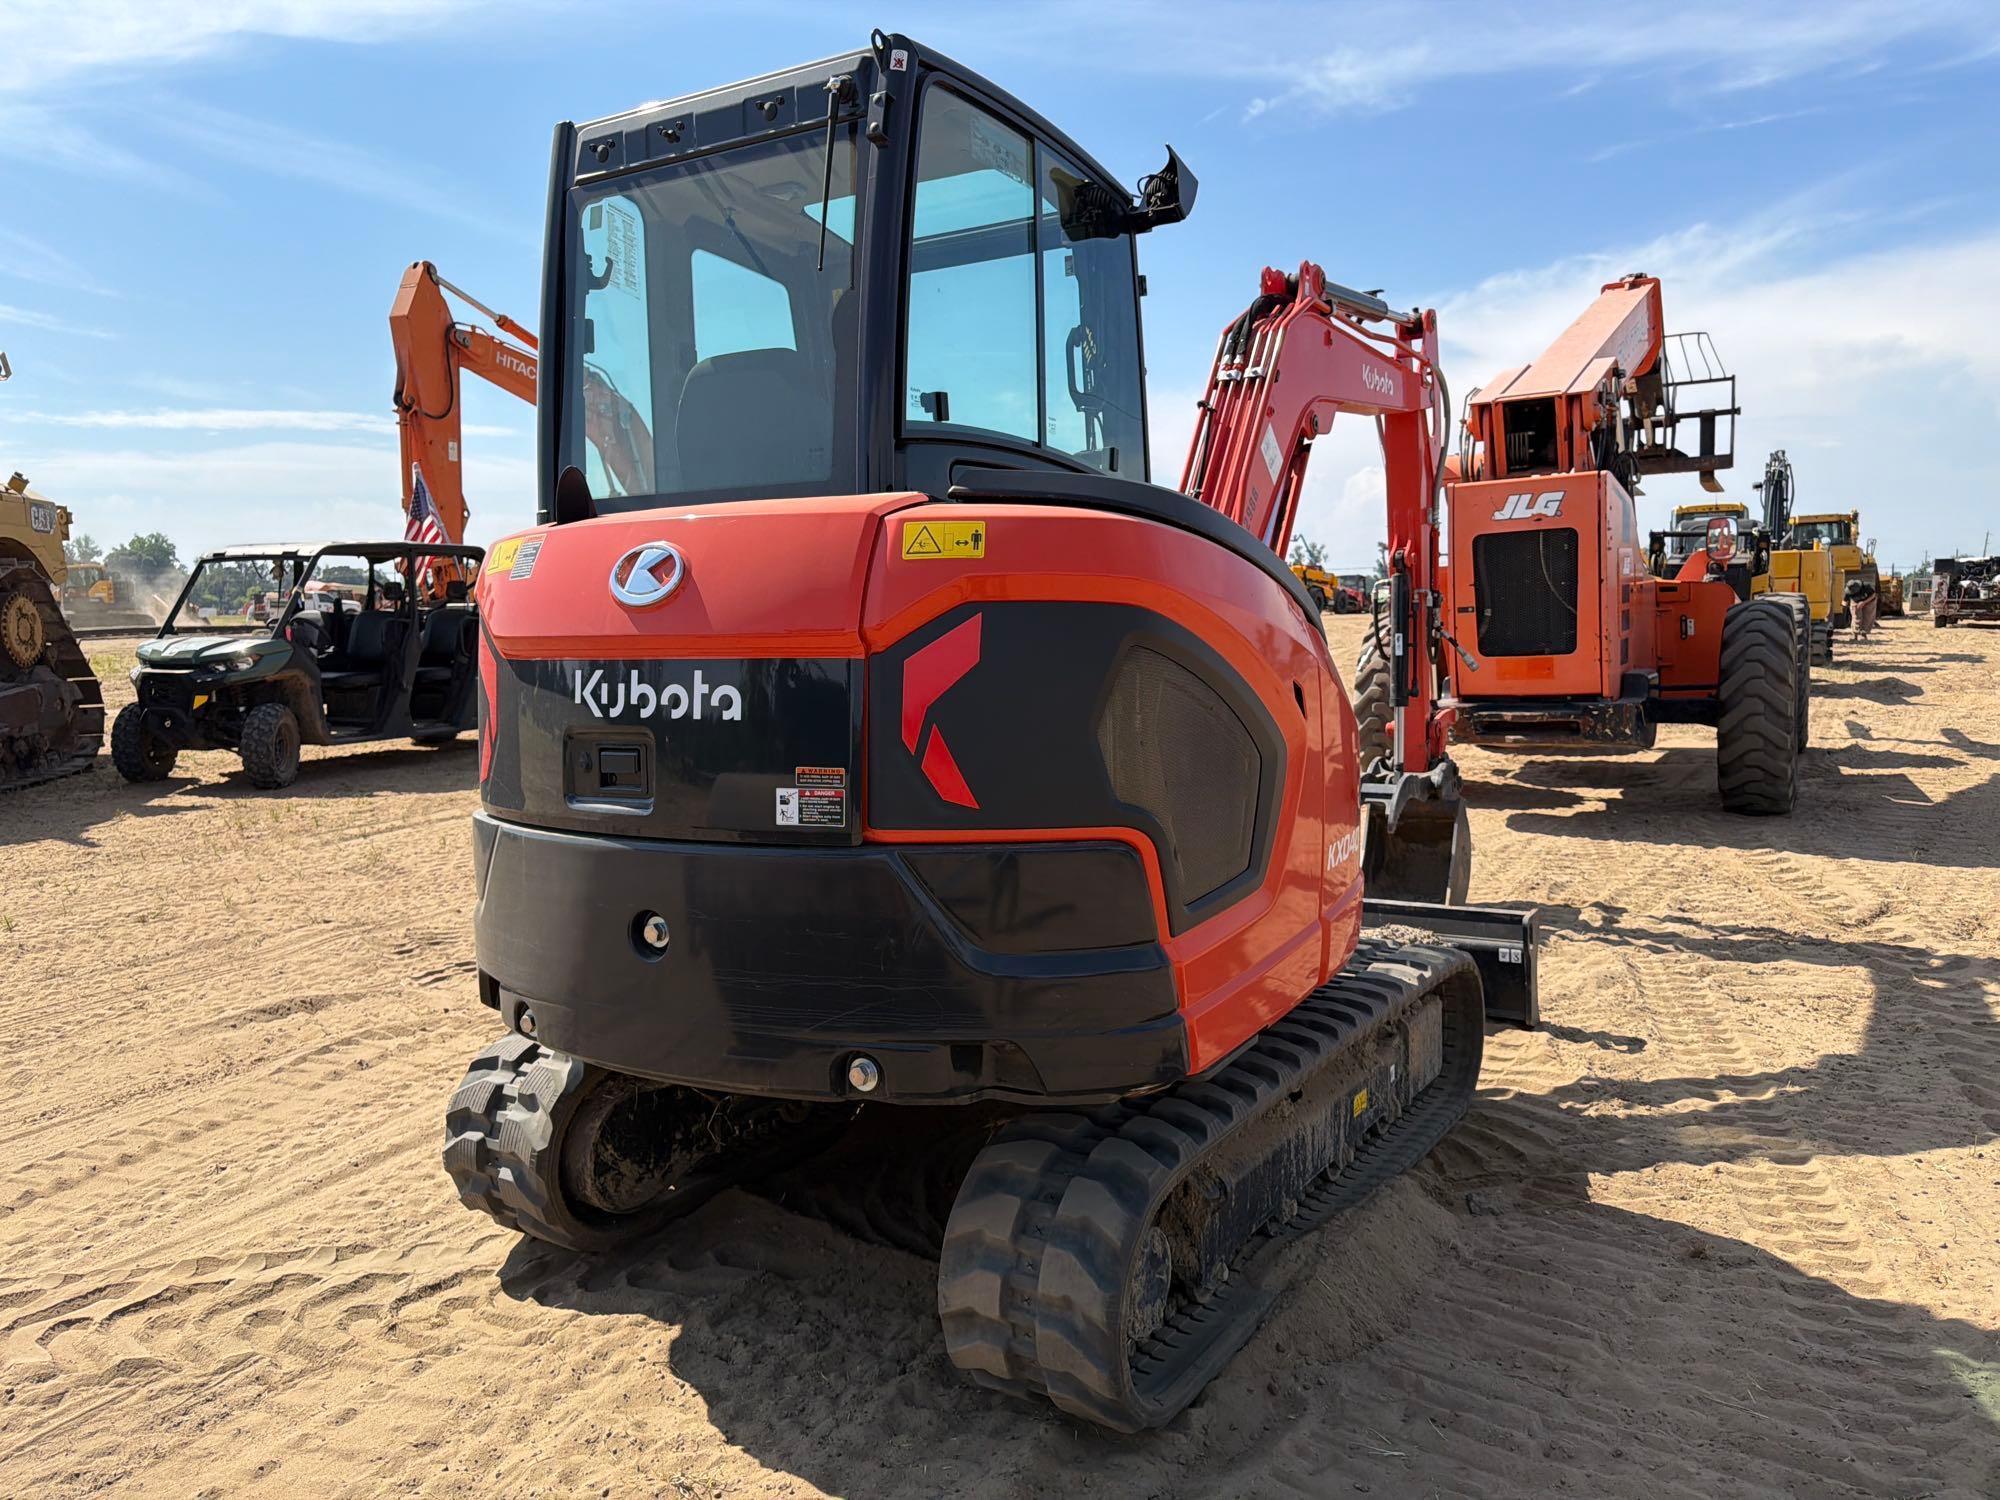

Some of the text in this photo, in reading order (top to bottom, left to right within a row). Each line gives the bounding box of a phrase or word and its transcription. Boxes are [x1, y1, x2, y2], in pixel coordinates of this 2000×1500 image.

[1362, 363, 1394, 396] Kubota
[1491, 490, 1566, 520] JLG
[574, 669, 742, 720] Kubota
